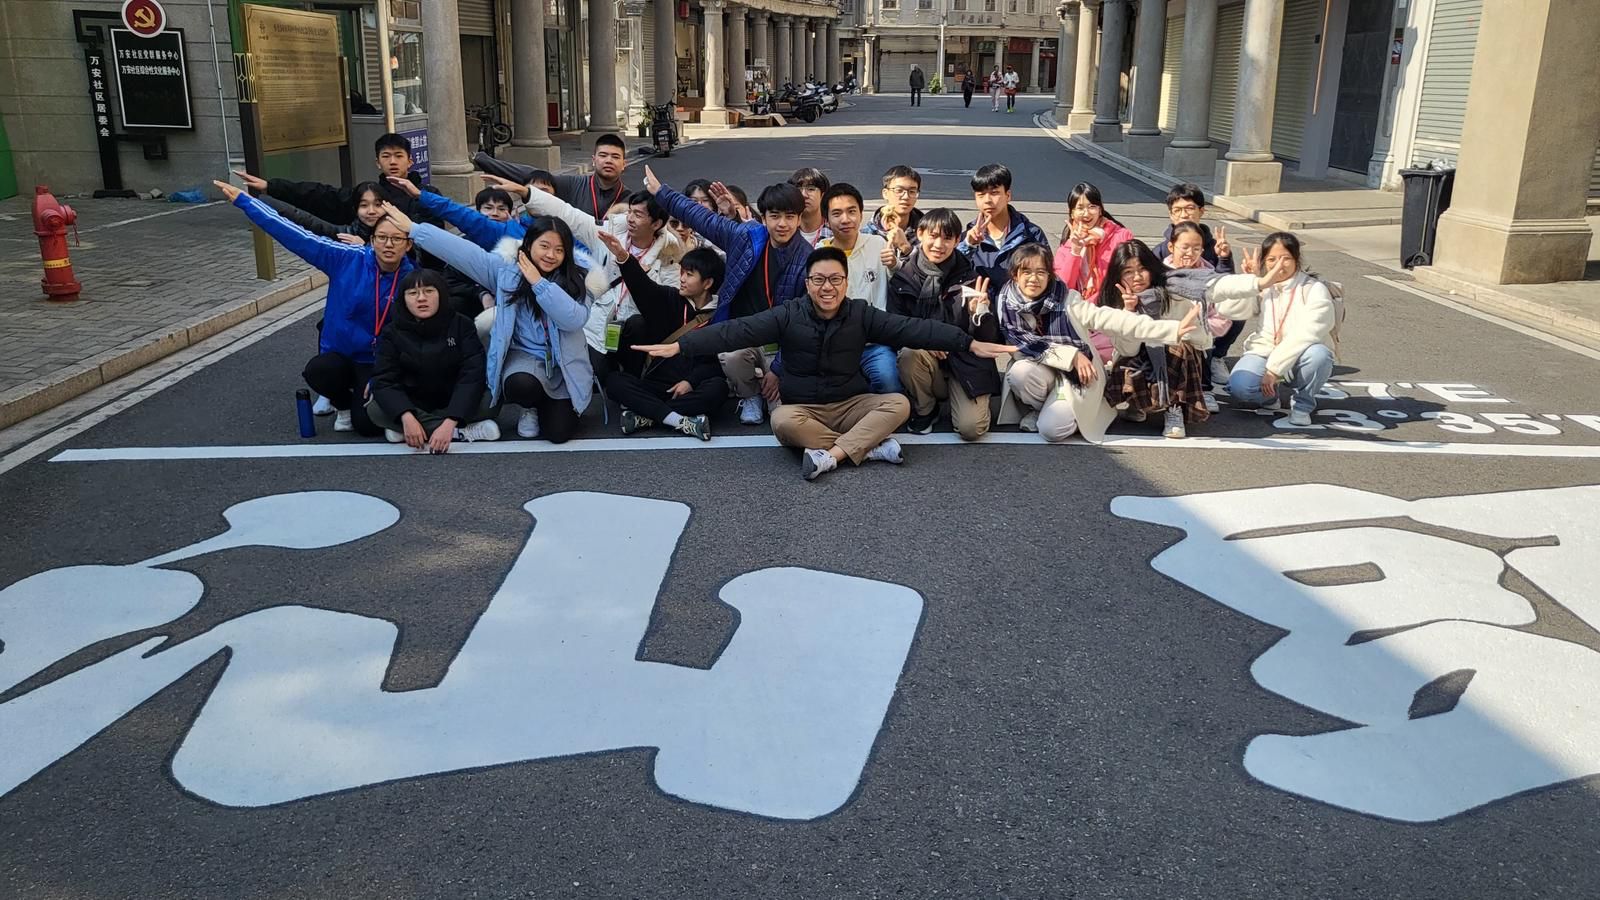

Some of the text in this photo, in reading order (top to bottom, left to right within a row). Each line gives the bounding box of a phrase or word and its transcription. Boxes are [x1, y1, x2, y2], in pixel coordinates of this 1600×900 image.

[118, 49, 179, 60] 万安社区党群服务中心
[89, 55, 110, 137] 万安社区居委会
